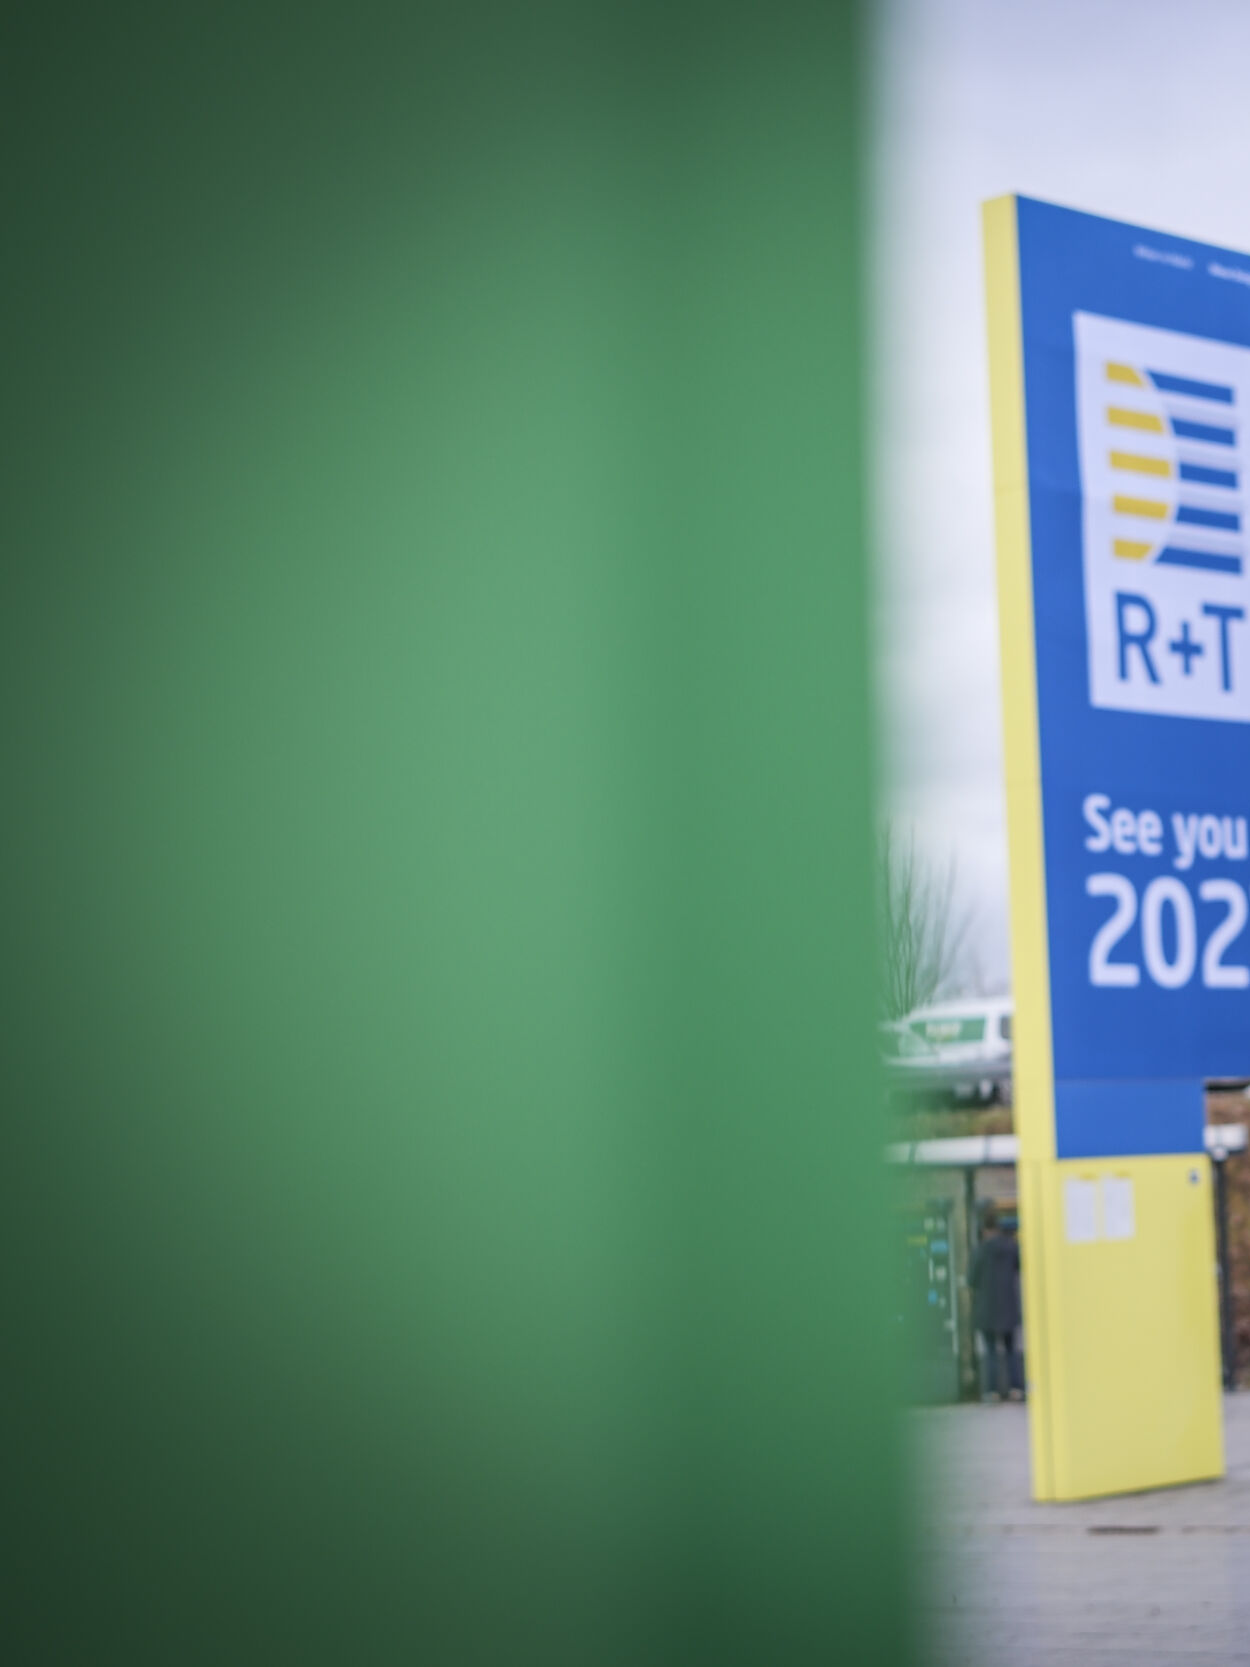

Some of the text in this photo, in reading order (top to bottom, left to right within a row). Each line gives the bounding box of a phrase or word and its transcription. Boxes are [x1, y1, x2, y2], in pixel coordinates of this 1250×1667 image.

[1115, 592, 1245, 693] R+T
[1083, 794, 1163, 856] See
[1172, 811, 1248, 870] you
